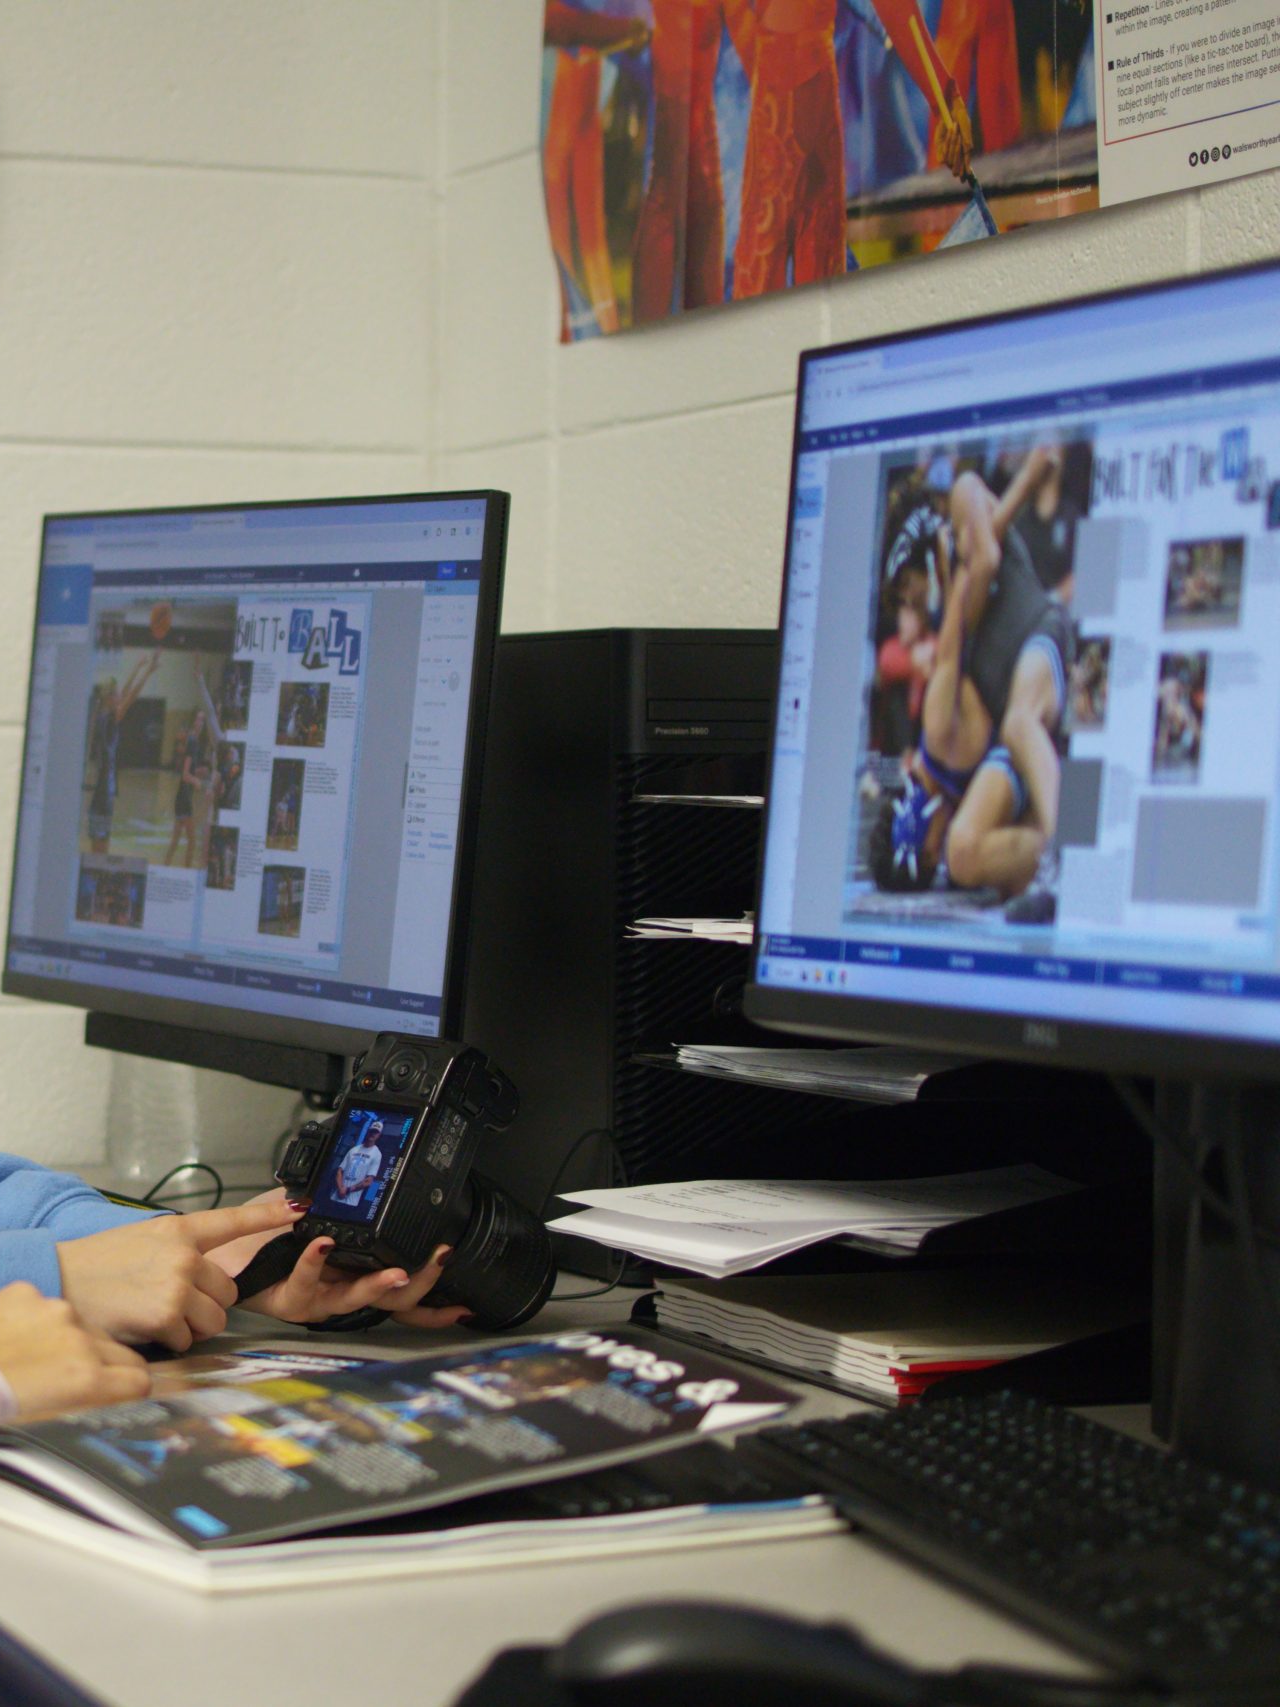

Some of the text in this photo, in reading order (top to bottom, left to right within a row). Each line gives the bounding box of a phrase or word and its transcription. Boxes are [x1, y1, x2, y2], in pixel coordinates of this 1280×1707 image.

[1115, 5, 1150, 21] Repetition
[1115, 22, 1136, 36] within
[1174, 4, 1203, 19] creating
[1116, 56, 1132, 69] Rule
[1132, 53, 1140, 64] of
[1142, 47, 1165, 61] Thirds
[1170, 43, 1176, 55] If
[1176, 42, 1190, 55] you
[1191, 36, 1209, 49] were
[1210, 34, 1218, 44] to
[1219, 26, 1241, 41] divide
[1242, 25, 1251, 35] an
[1252, 18, 1276, 32] image
[1117, 71, 1131, 83] nine
[1132, 65, 1152, 79] equal
[1152, 56, 1183, 73] sections
[1207, 43, 1244, 60] tic-tac-toe
[1117, 84, 1134, 98] focal
[1135, 80, 1153, 95] point
[1154, 75, 1170, 89] falls
[1171, 70, 1193, 84] where
[1194, 66, 1206, 78] the
[1207, 62, 1225, 75] lines
[1117, 98, 1142, 112] subject
[1143, 90, 1169, 107] slightly
[1169, 86, 1181, 99] off
[1181, 82, 1204, 96] center
[1205, 75, 1231, 89] makes
[1231, 71, 1244, 84] the
[1245, 65, 1268, 79] image
[1118, 114, 1135, 127] more
[288, 607, 361, 675] BALL
[390, 1156, 404, 1181] Nikon
